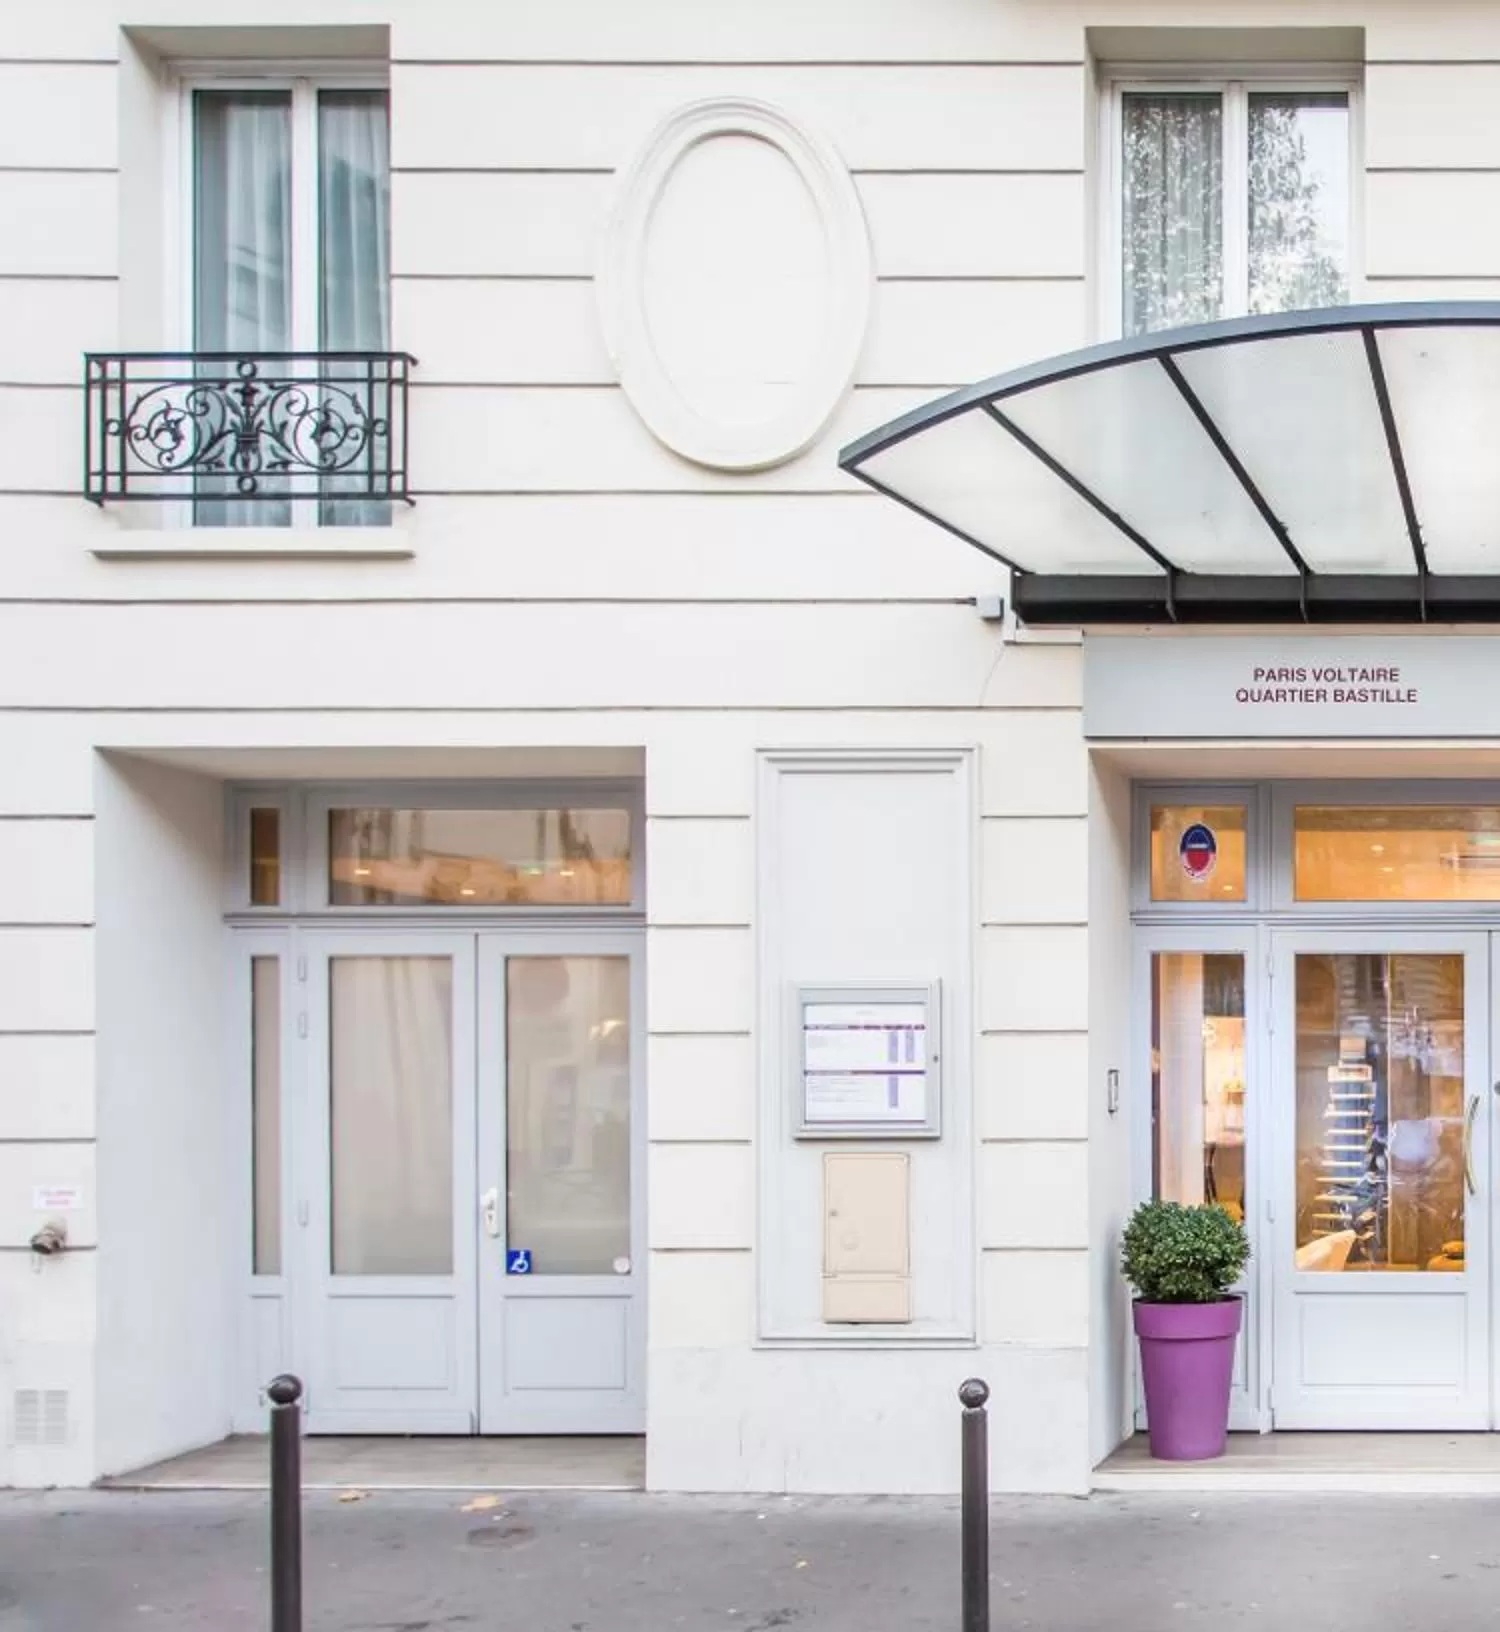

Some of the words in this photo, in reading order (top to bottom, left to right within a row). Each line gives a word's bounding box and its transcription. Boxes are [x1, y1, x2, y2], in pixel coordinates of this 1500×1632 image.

[1253, 667, 1307, 683] PARIS
[1312, 667, 1400, 683] VOLTAIRE
[1235, 688, 1328, 704] QUARTIER
[1333, 688, 1418, 704] BASTILLE
